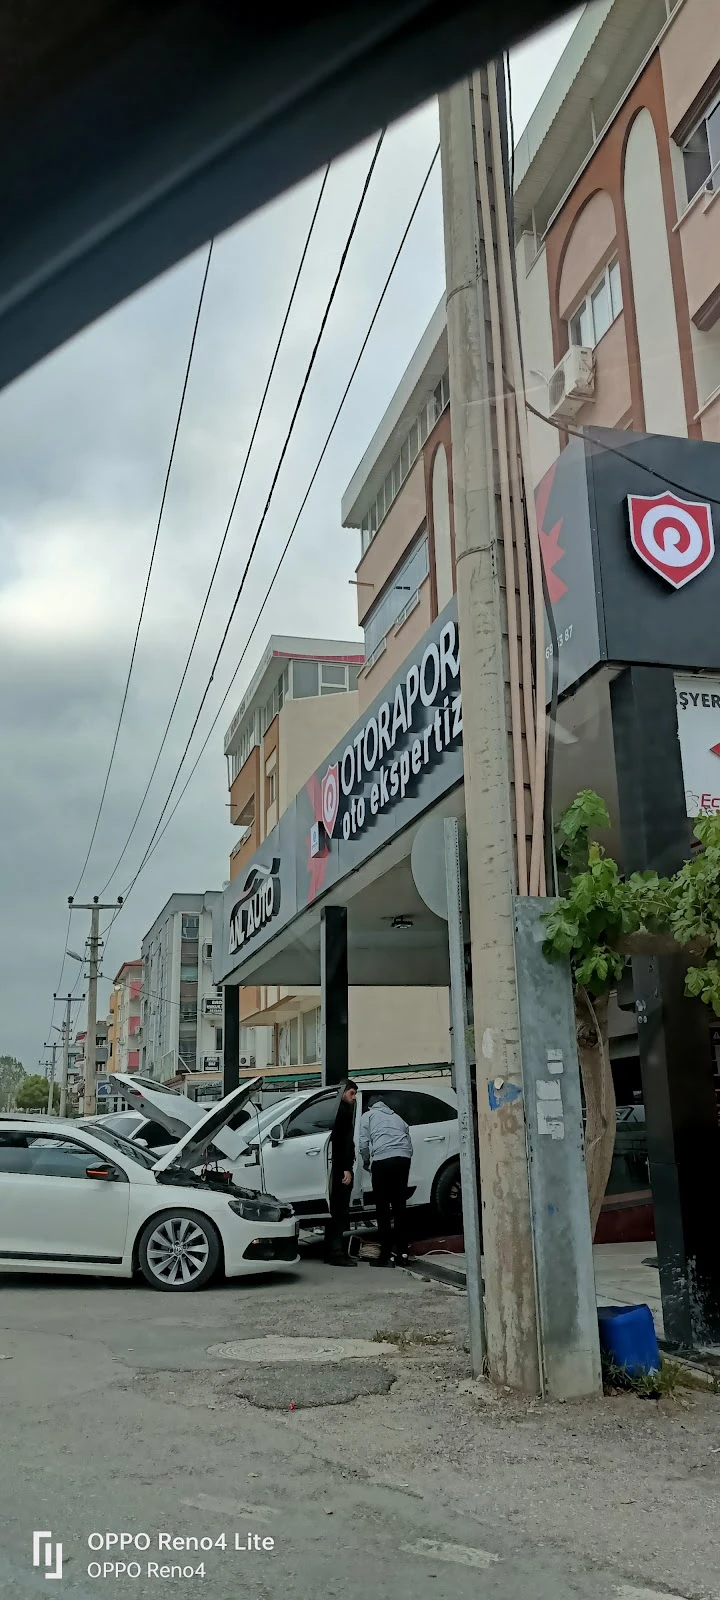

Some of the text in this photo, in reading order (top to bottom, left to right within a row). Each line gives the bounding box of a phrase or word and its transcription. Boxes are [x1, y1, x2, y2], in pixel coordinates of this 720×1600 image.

[564, 624, 573, 641] 87
[341, 620, 460, 796] OTORAPOR
[675, 688, 720, 710] ŞYER
[342, 694, 463, 840] oto ekspertiz
[246, 876, 274, 938] AUTO
